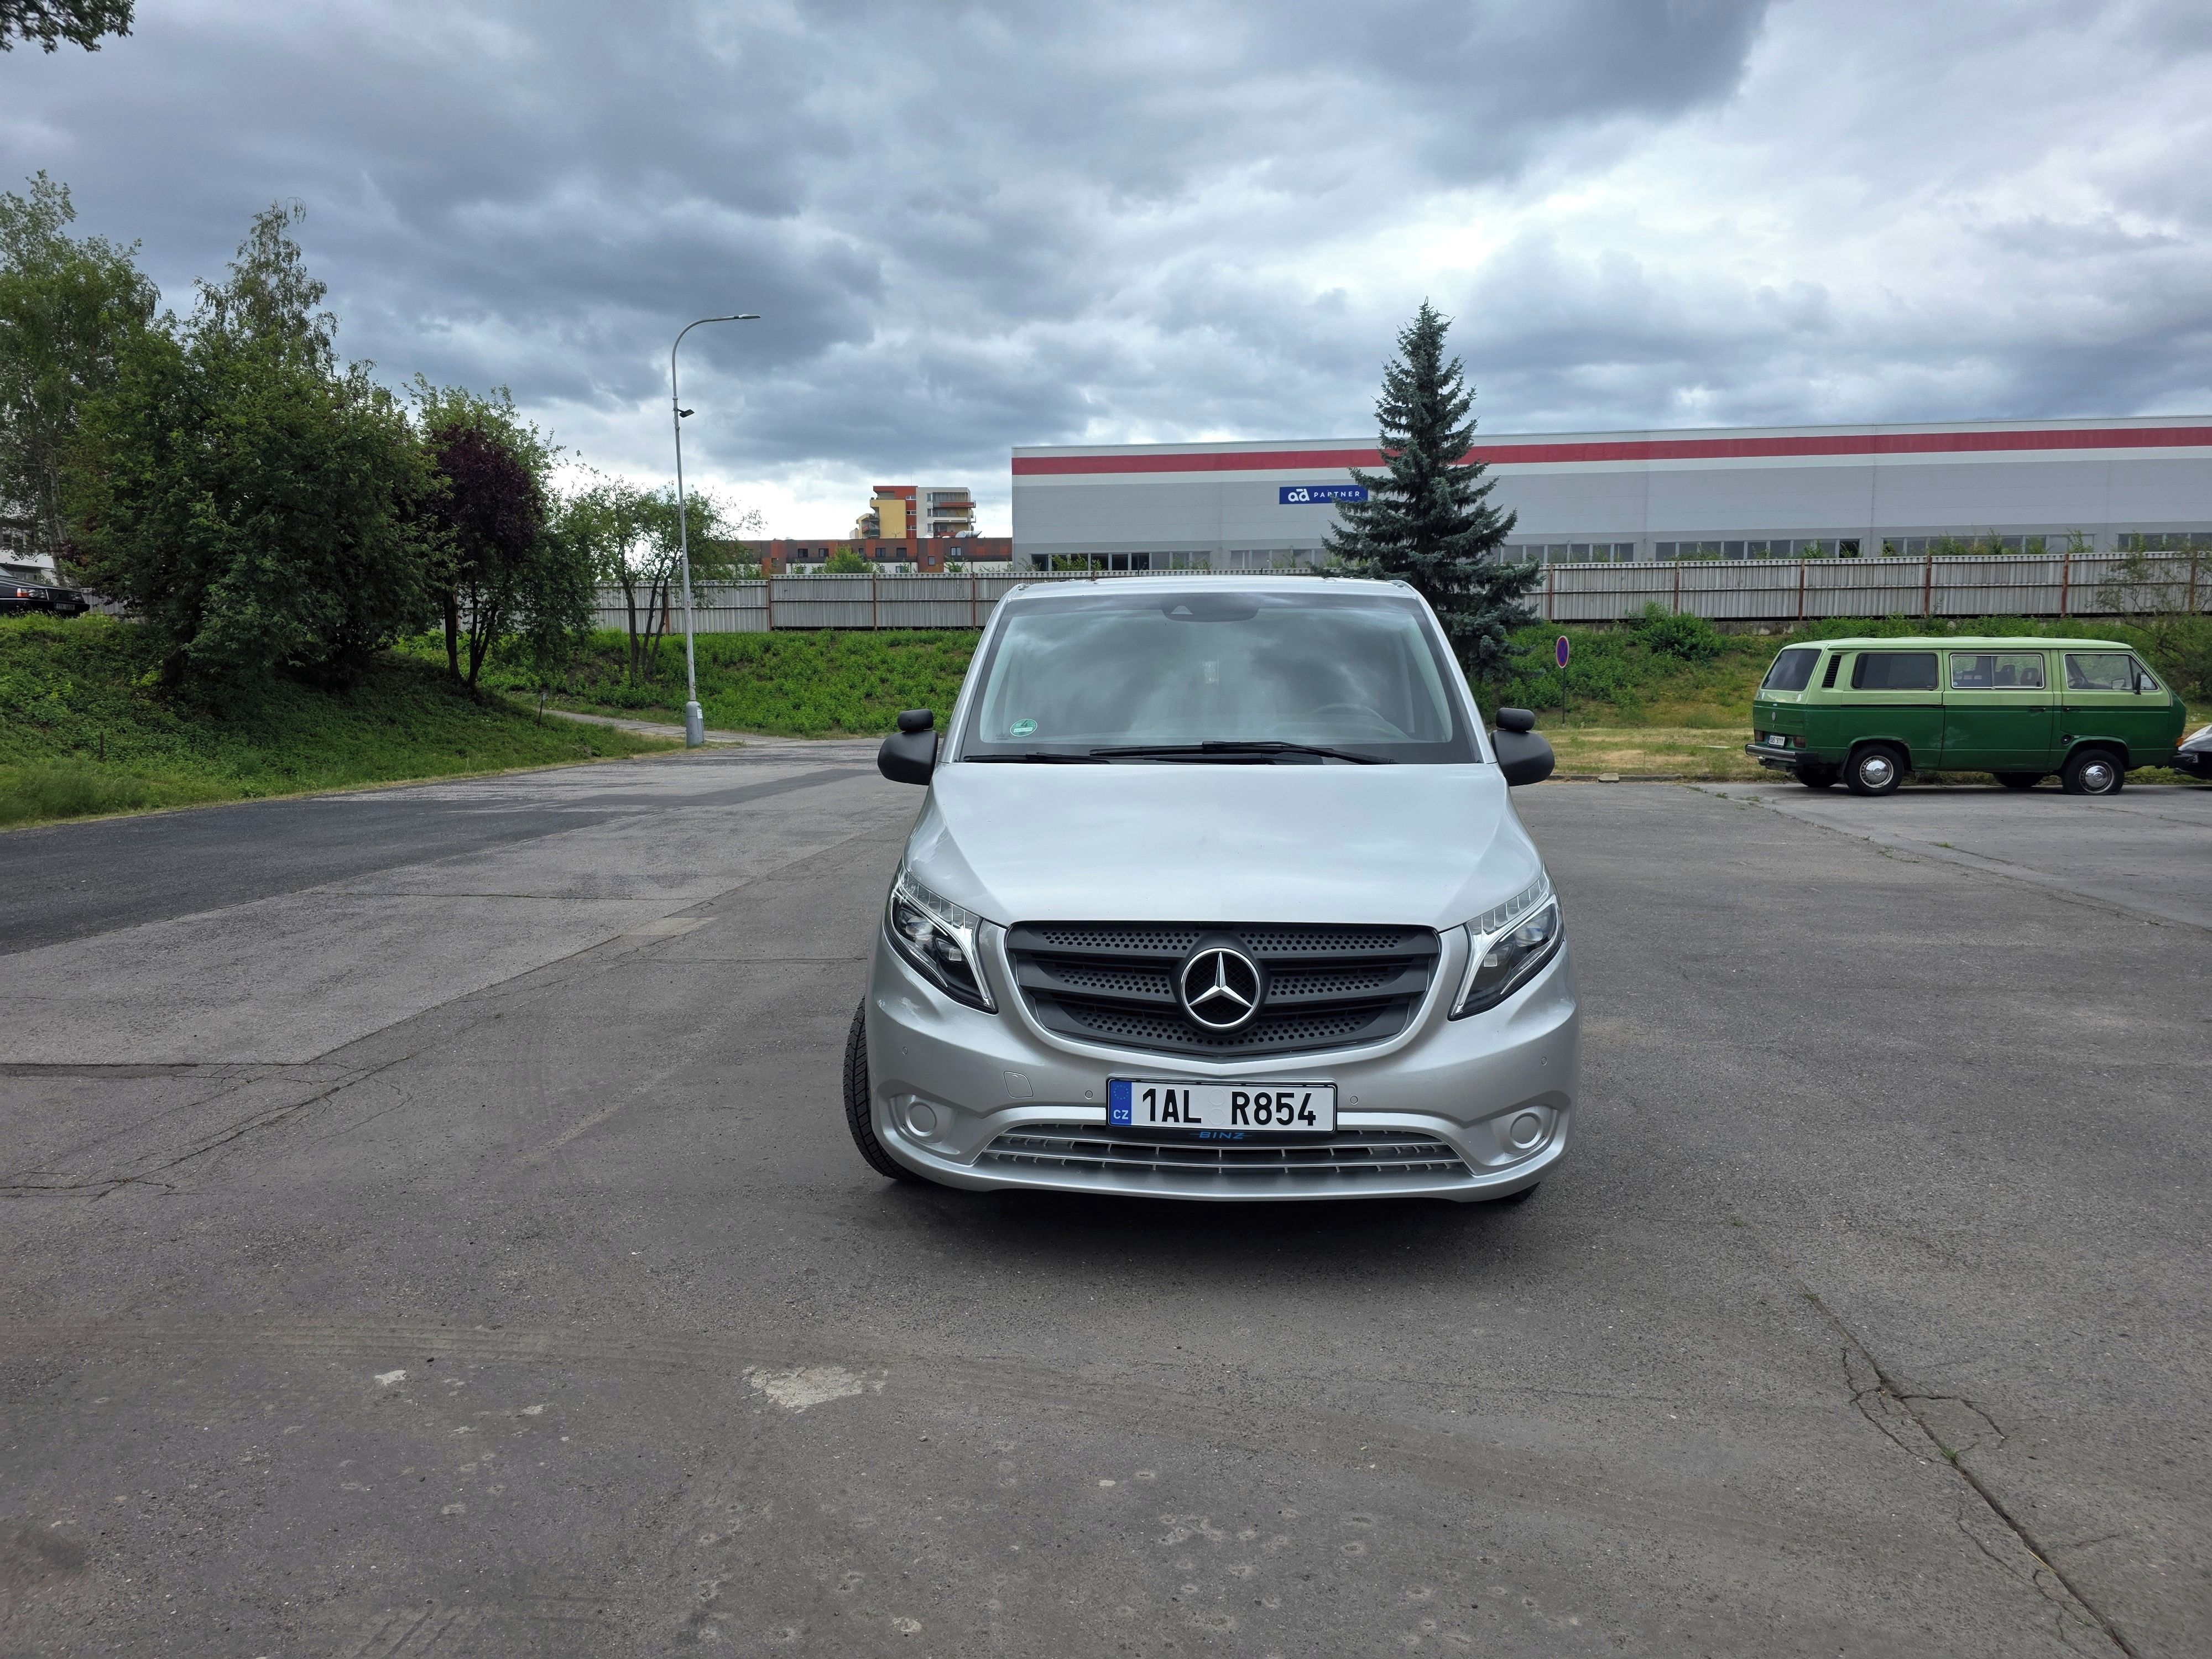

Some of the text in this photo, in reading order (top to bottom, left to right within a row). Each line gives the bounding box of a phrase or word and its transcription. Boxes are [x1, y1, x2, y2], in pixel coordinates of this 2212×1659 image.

[1020, 719, 1028, 728] 4
[1142, 1088, 1317, 1126] 1AL R854
[1113, 1109, 1129, 1120] CZ
